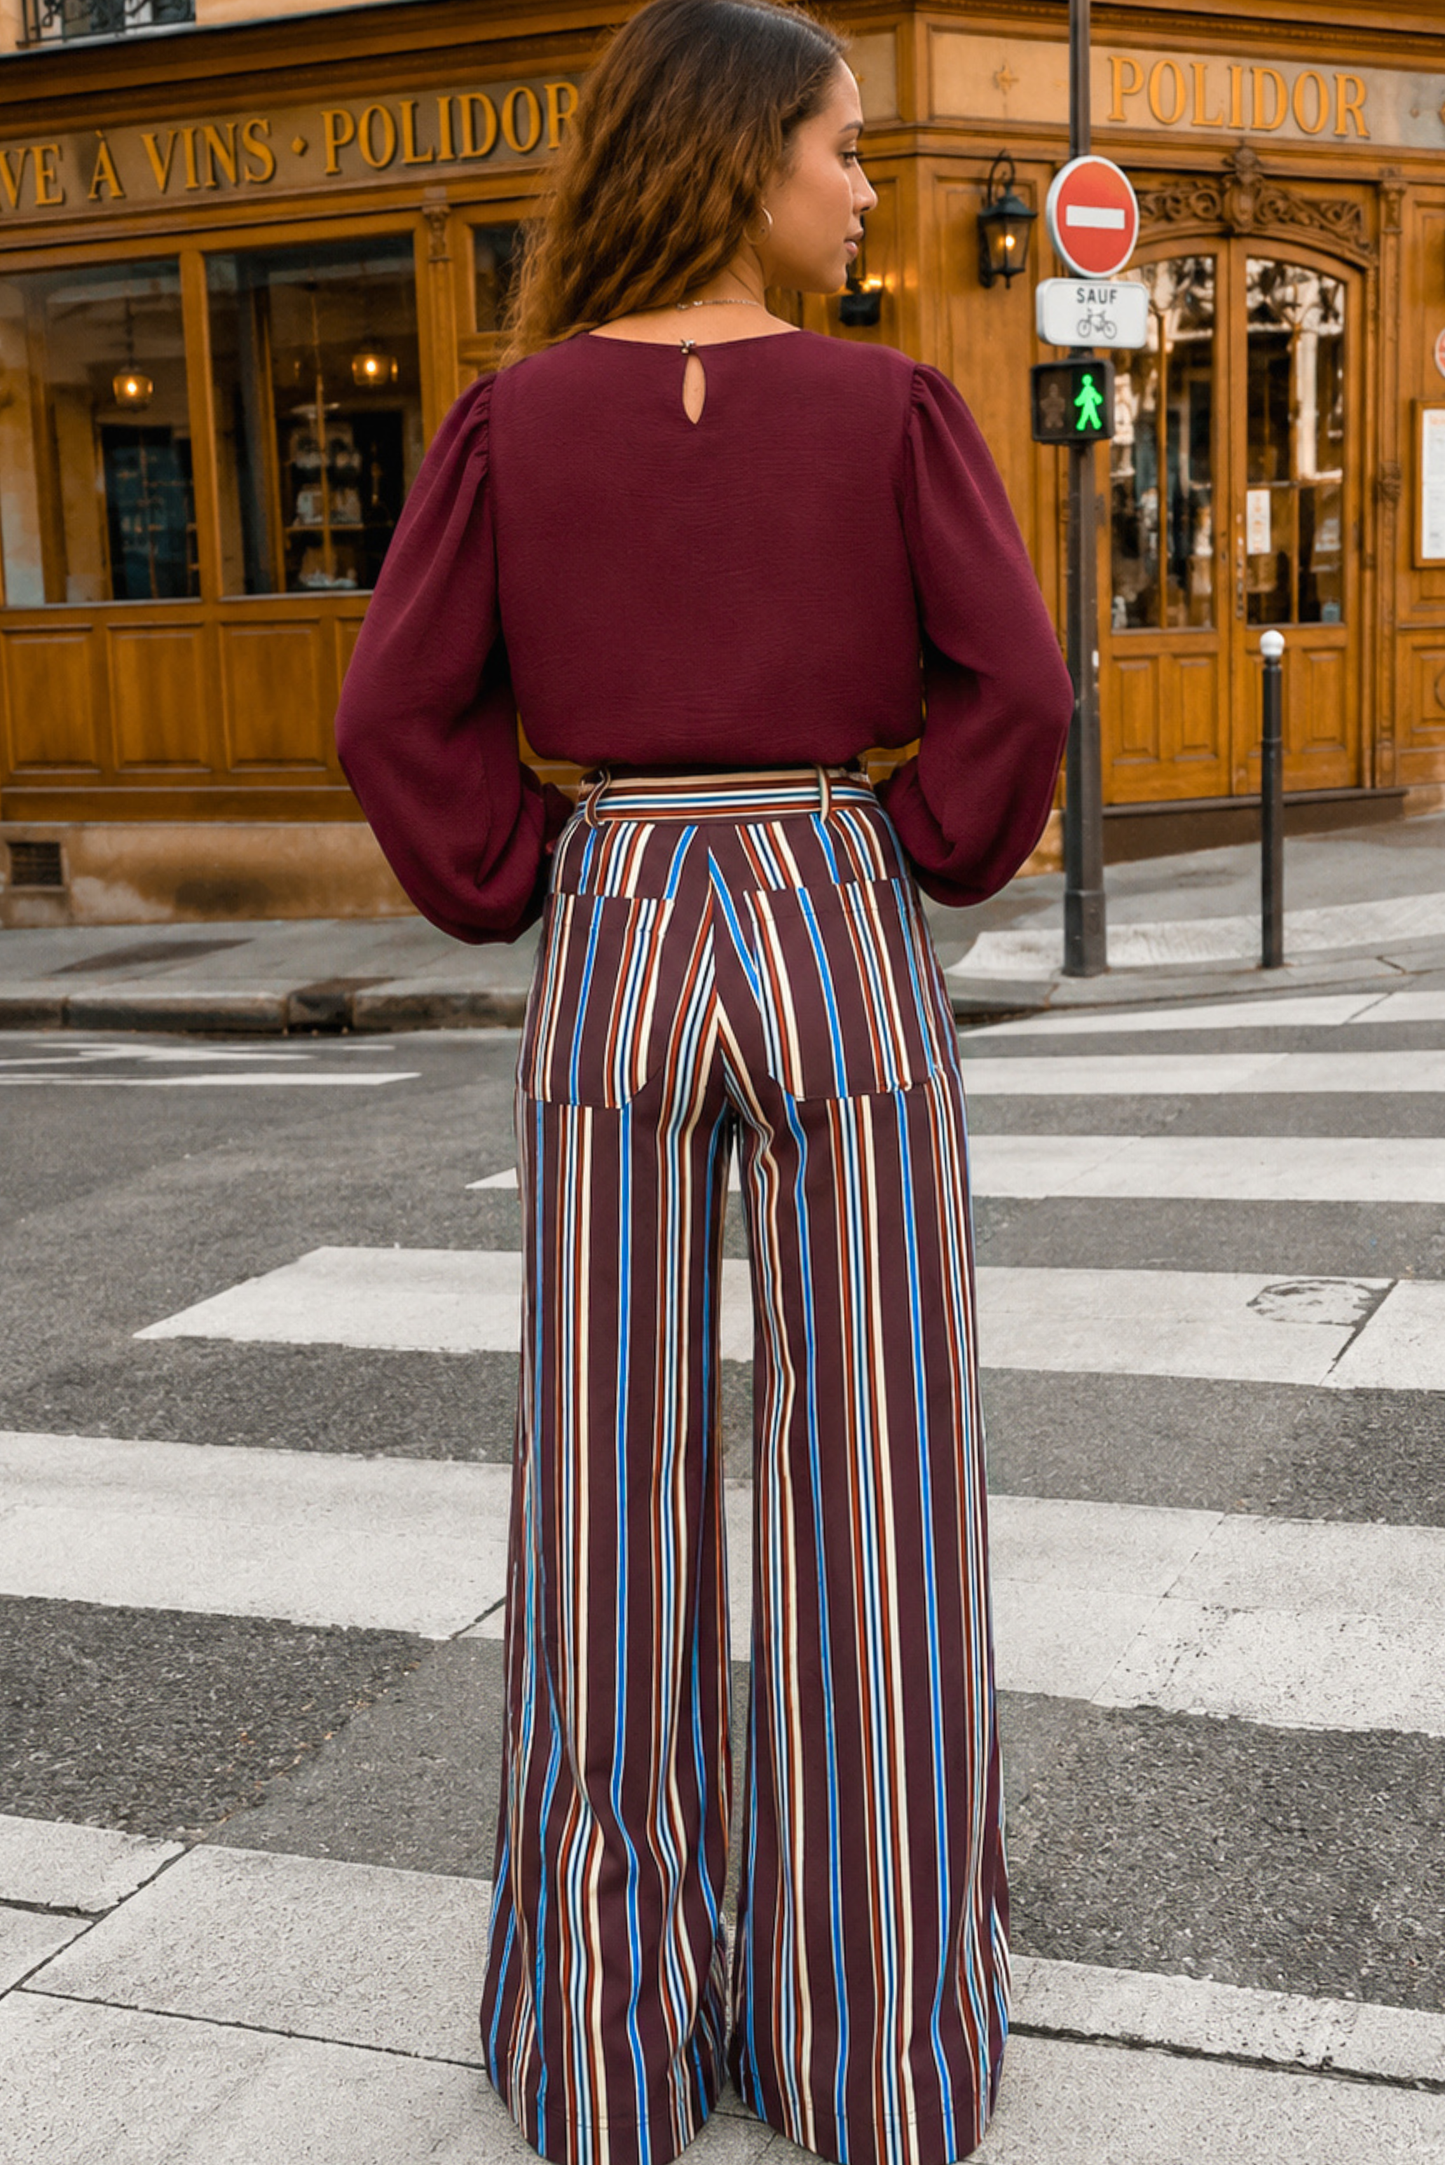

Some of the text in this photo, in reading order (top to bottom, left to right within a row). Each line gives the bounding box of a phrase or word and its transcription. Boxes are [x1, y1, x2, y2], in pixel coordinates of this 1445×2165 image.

[1107, 55, 1370, 138] POLIDOR
[87, 129, 125, 199] À
[141, 118, 275, 192] VINS
[320, 82, 579, 174] POLIDOR
[1076, 286, 1118, 305] SAUF
